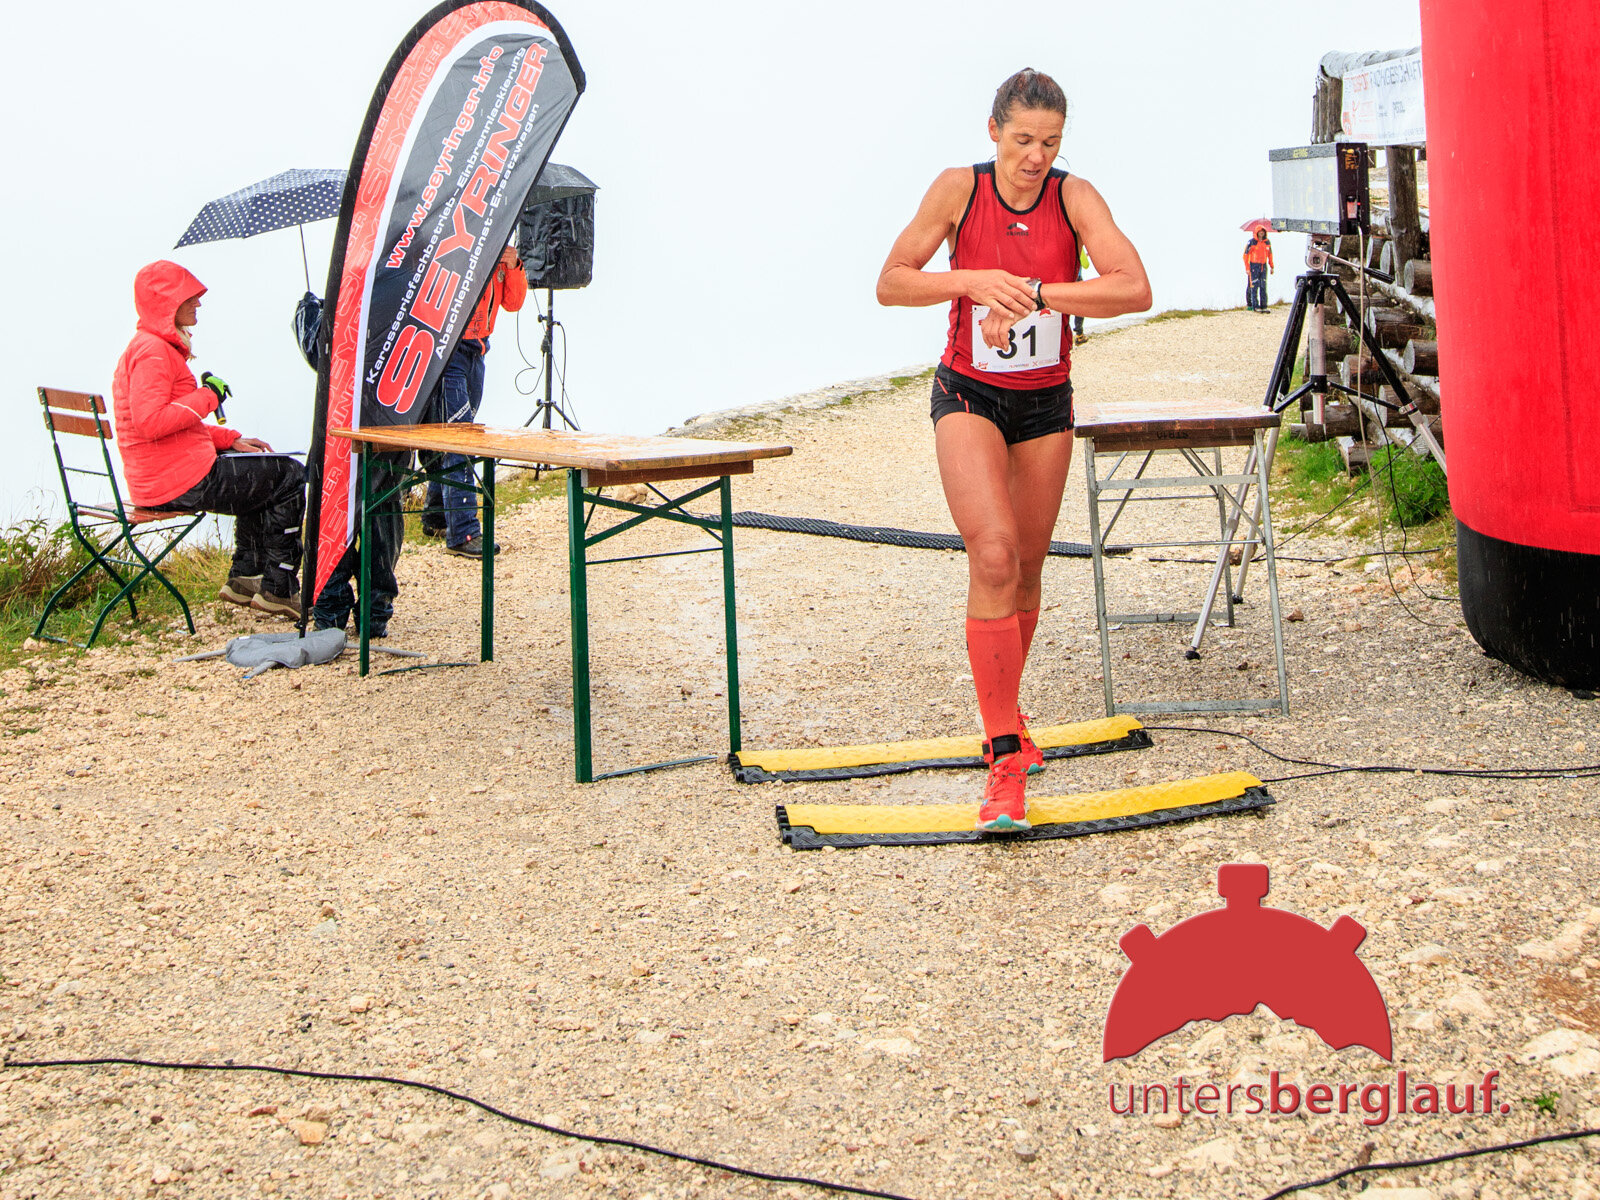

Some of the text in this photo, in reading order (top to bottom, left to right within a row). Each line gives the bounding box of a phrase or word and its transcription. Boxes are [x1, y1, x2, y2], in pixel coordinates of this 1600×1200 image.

[376, 42, 549, 415] SEYRINGER
[385, 45, 504, 269] www.seyringer.info
[434, 103, 540, 360] Abschleppdienst-Ersatzwagen
[996, 325, 1036, 359] 31
